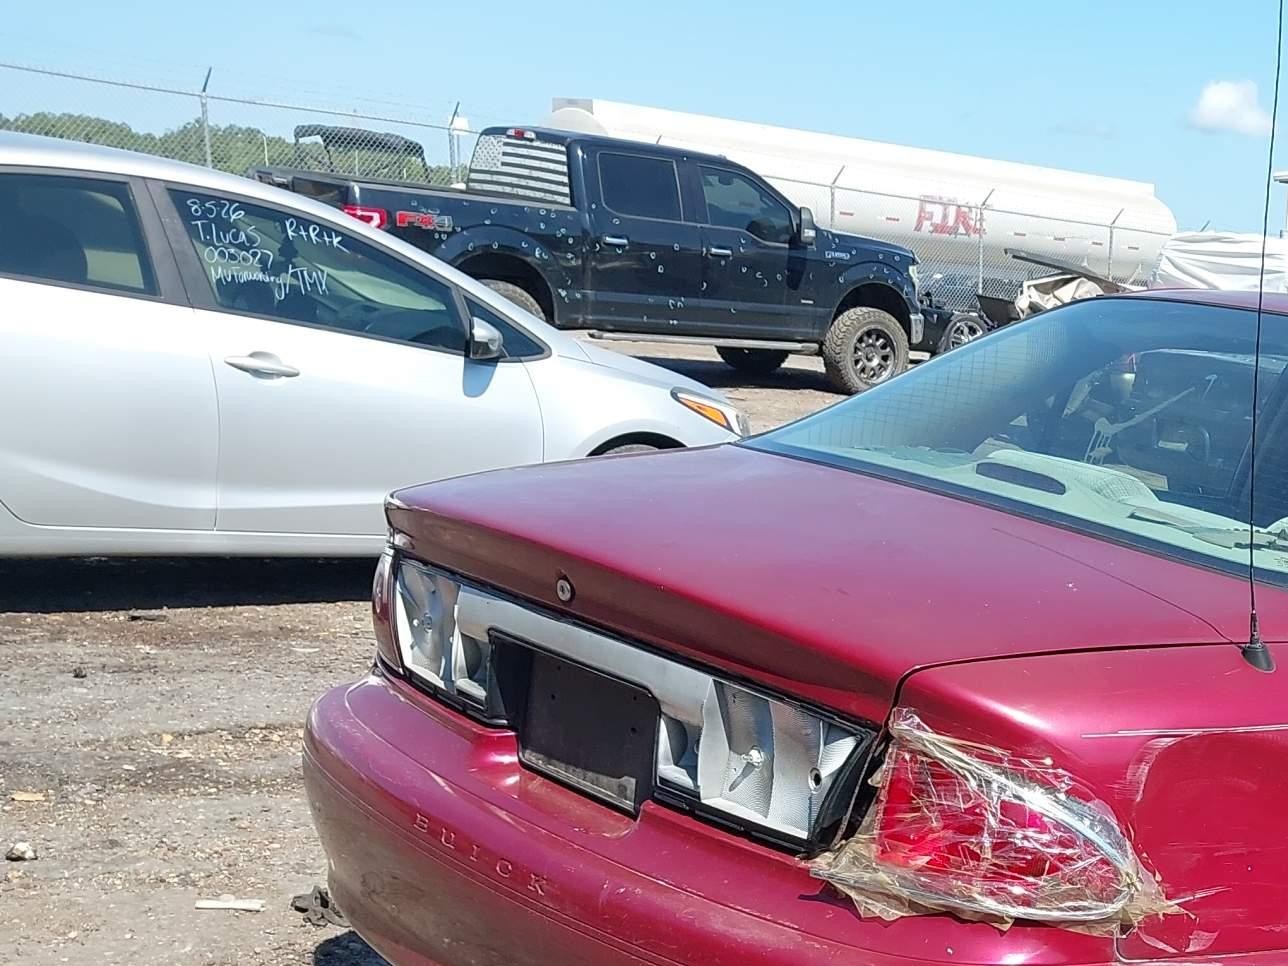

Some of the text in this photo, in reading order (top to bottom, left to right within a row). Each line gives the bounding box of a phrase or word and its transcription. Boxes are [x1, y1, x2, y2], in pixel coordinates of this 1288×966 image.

[396, 211, 453, 232] FX4
[204, 246, 274, 269] 003027
[413, 812, 547, 896] BUICK
